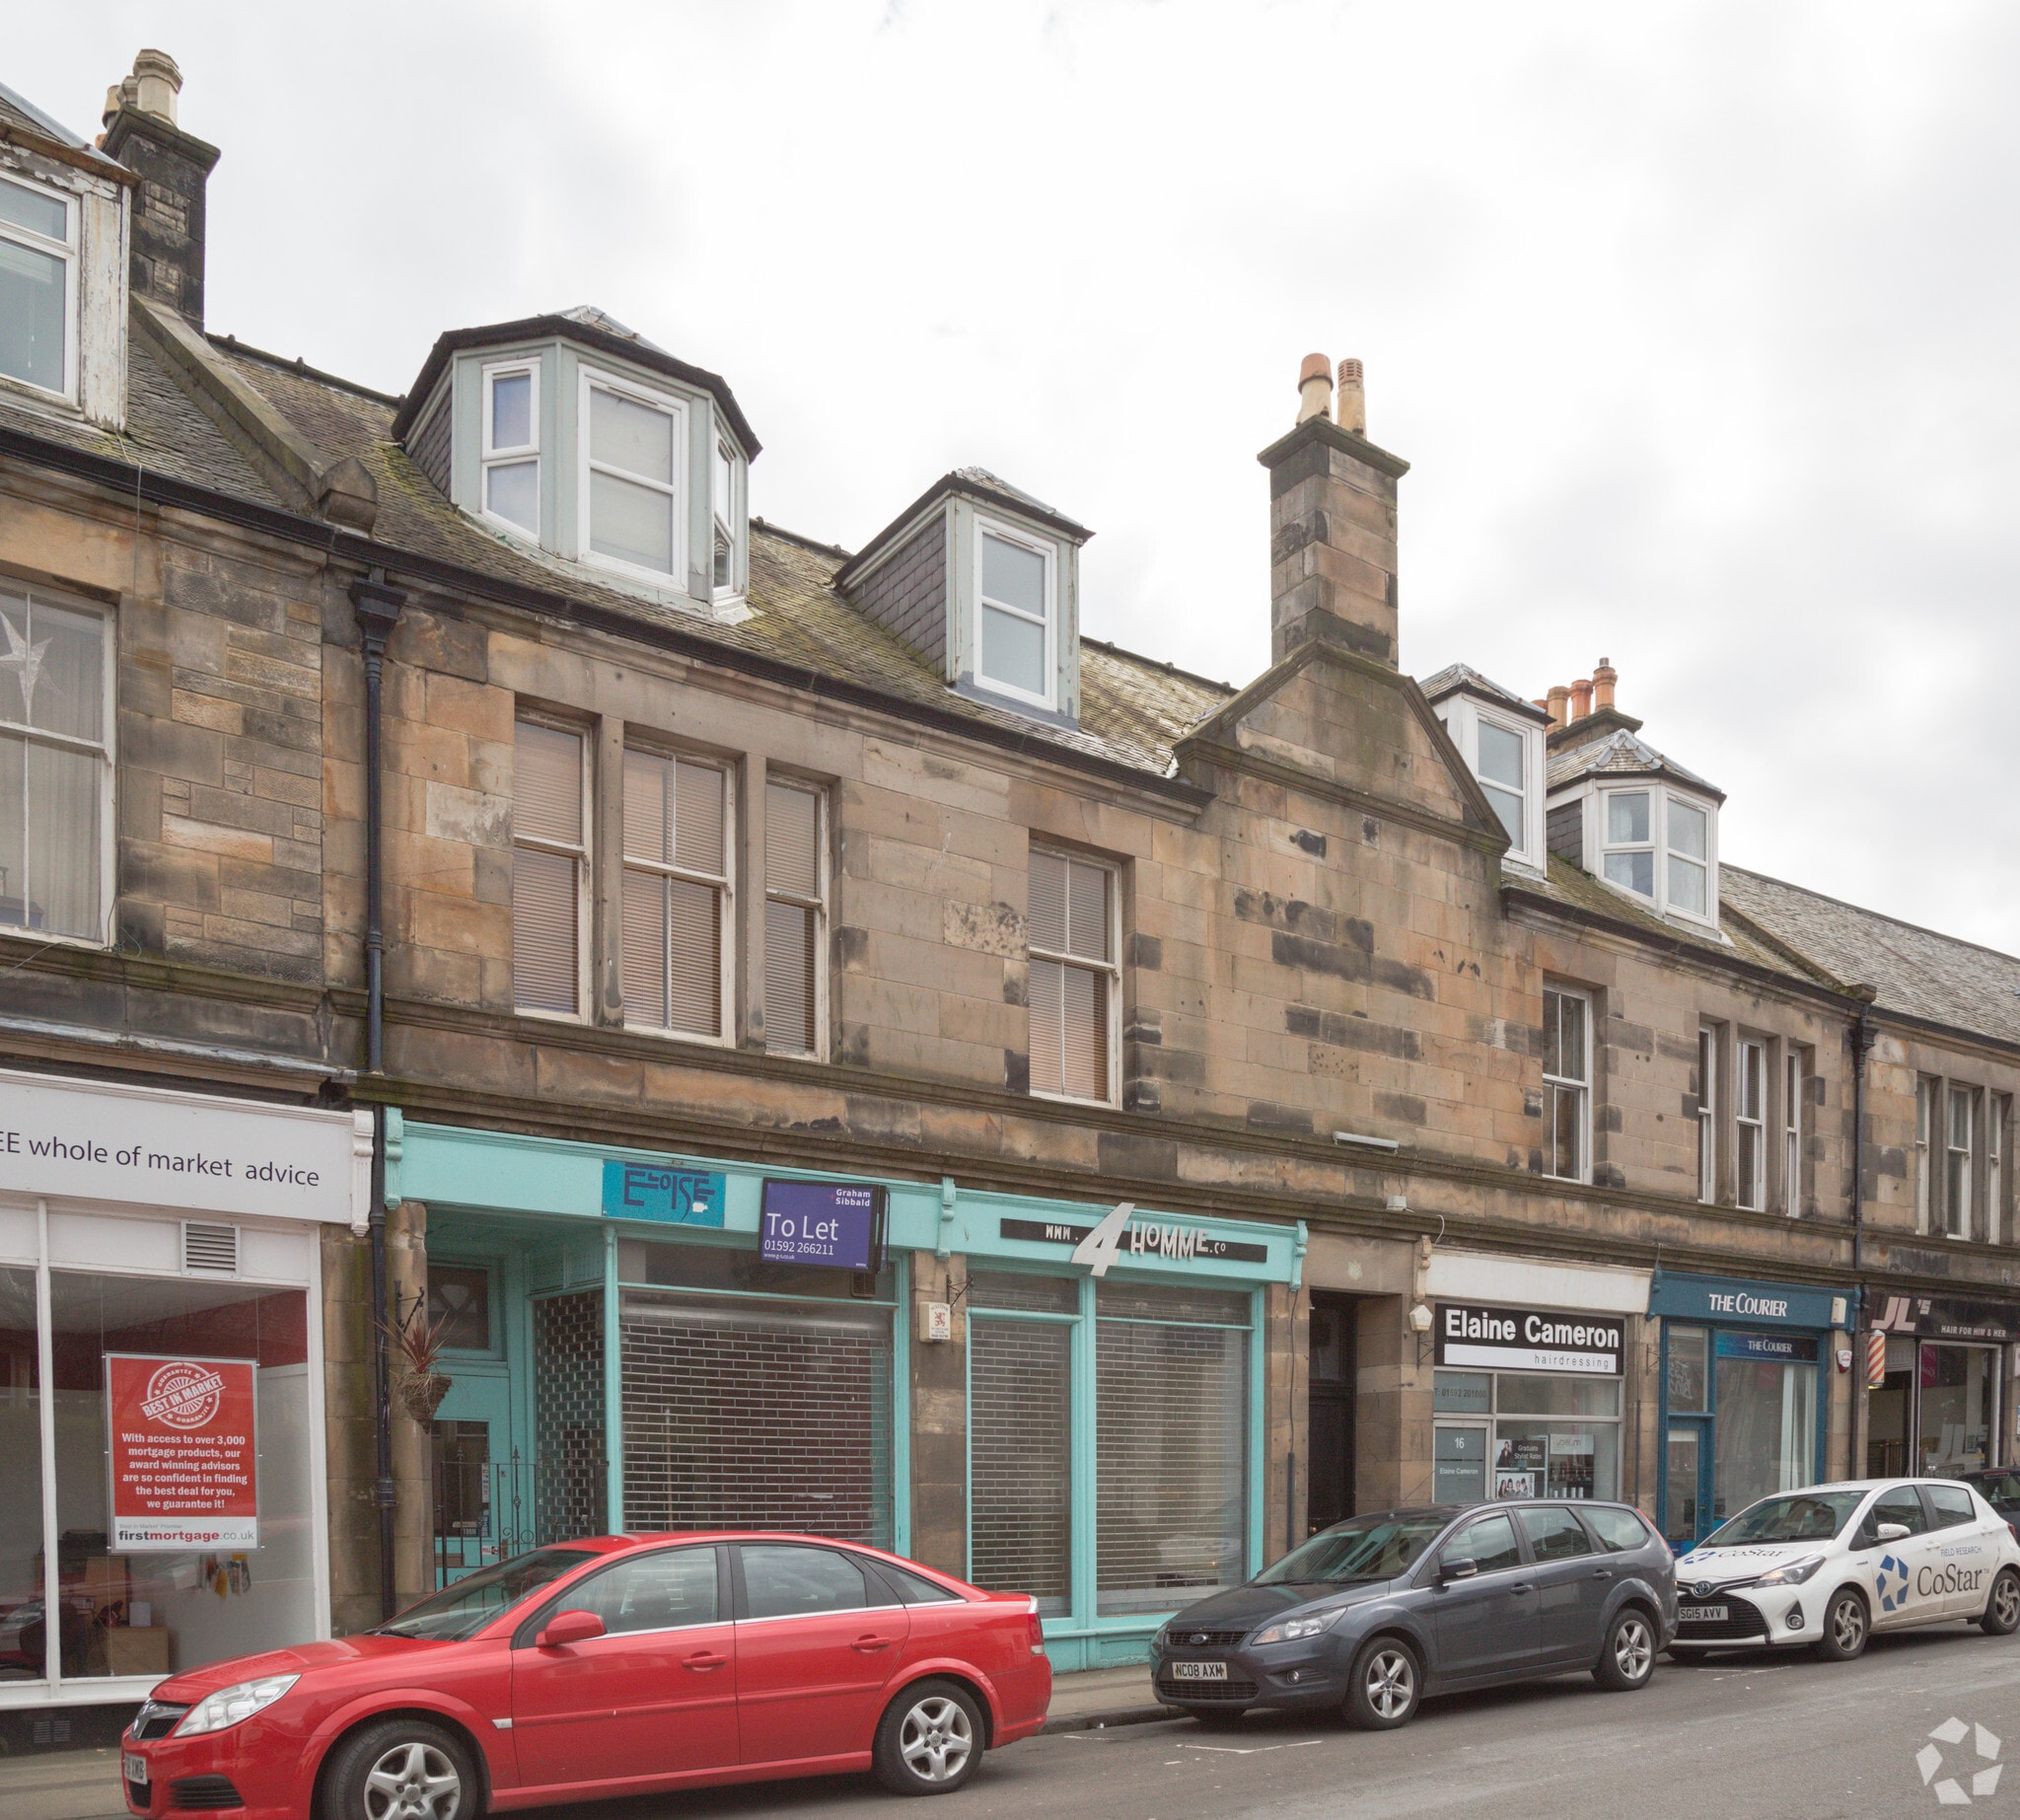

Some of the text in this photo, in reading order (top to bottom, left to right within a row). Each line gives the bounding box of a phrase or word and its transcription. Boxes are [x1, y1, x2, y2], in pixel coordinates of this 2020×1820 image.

[29, 1135, 108, 1163] whole
[115, 1145, 142, 1166] of
[148, 1152, 233, 1178] market
[246, 1161, 320, 1186] advice
[835, 1189, 871, 1198] Graham
[835, 1198, 870, 1206] Sibbald
[766, 1212, 839, 1241] To Let
[764, 1239, 834, 1256] 01592 266211
[1708, 1293, 1735, 1312] THE
[1445, 1309, 1620, 1348] Elaine Cameron
[1941, 1325, 1958, 1334] HAIR
[1747, 1340, 1763, 1350] THE
[1534, 1353, 1610, 1370] hairdressing
[141, 1374, 224, 1418] BEST IN MARKET
[121, 1432, 145, 1443] With
[147, 1435, 181, 1444] access
[182, 1434, 193, 1444] to
[216, 1435, 246, 1446] 3,000
[1455, 1437, 1465, 1449] 16
[128, 1447, 176, 1458] mortgage
[178, 1448, 223, 1458] products,
[129, 1460, 241, 1472] award winning advisors
[122, 1474, 139, 1483] are
[154, 1473, 201, 1484] confident
[202, 1474, 212, 1484] in
[214, 1475, 248, 1486] finding
[135, 1486, 153, 1495] the
[154, 1487, 176, 1496] best
[178, 1487, 198, 1496] deal
[200, 1487, 215, 1496] for
[163, 1499, 212, 1510] guarantee
[214, 1499, 225, 1508] it!
[118, 1530, 254, 1543] firstmortgage.co.uk
[1718, 1547, 1787, 1559] CoStar
[1940, 1546, 1983, 1557] FIELD RESEARCH
[1916, 1564, 1983, 1596] CoStar
[1680, 1607, 1722, 1620] SG15 AVV
[1202, 1663, 1223, 1677] AXM
